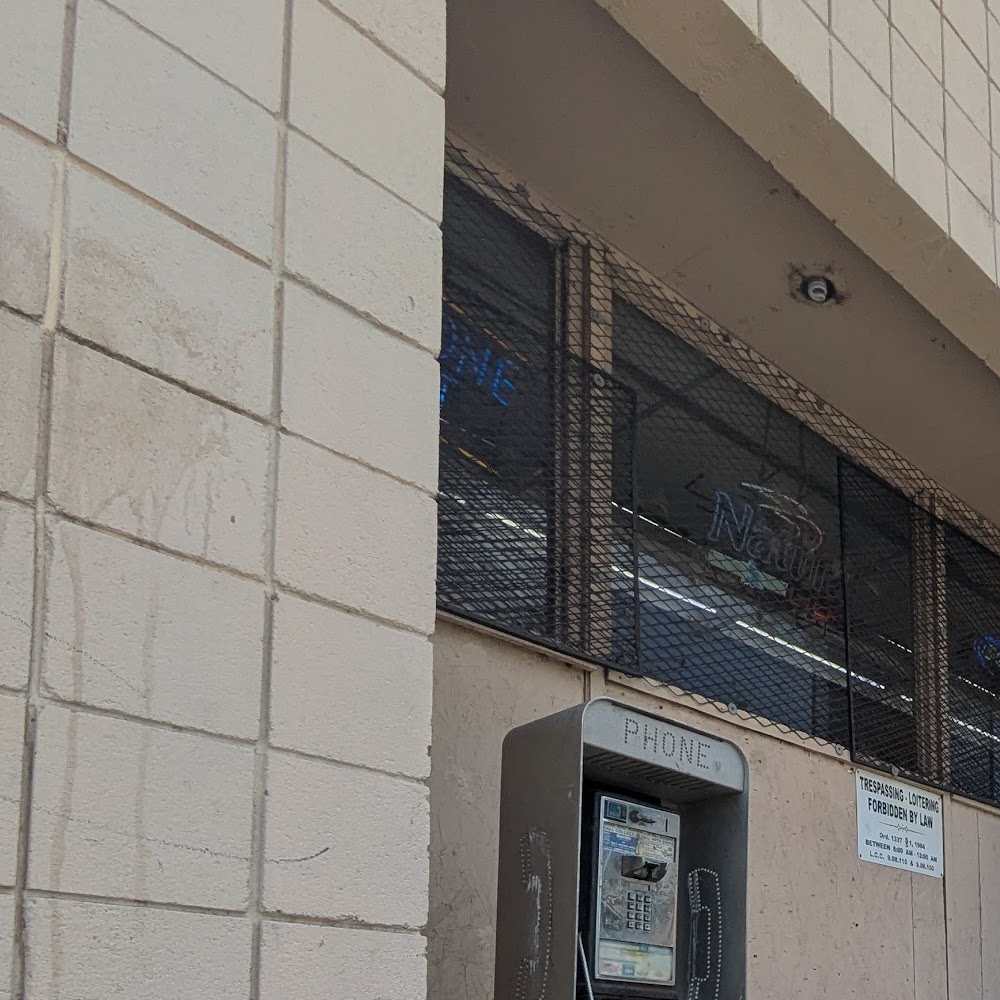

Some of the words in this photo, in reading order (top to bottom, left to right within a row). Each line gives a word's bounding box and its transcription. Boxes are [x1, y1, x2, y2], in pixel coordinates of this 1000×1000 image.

[624, 717, 711, 770] PHONE
[859, 776, 904, 802] TRESPASSING
[908, 792, 939, 813] LOITERING
[867, 797, 908, 821] FORBIDDEN
[909, 809, 918, 824] BY
[919, 812, 933, 829] LAW
[865, 839, 890, 850] BETWEEN
